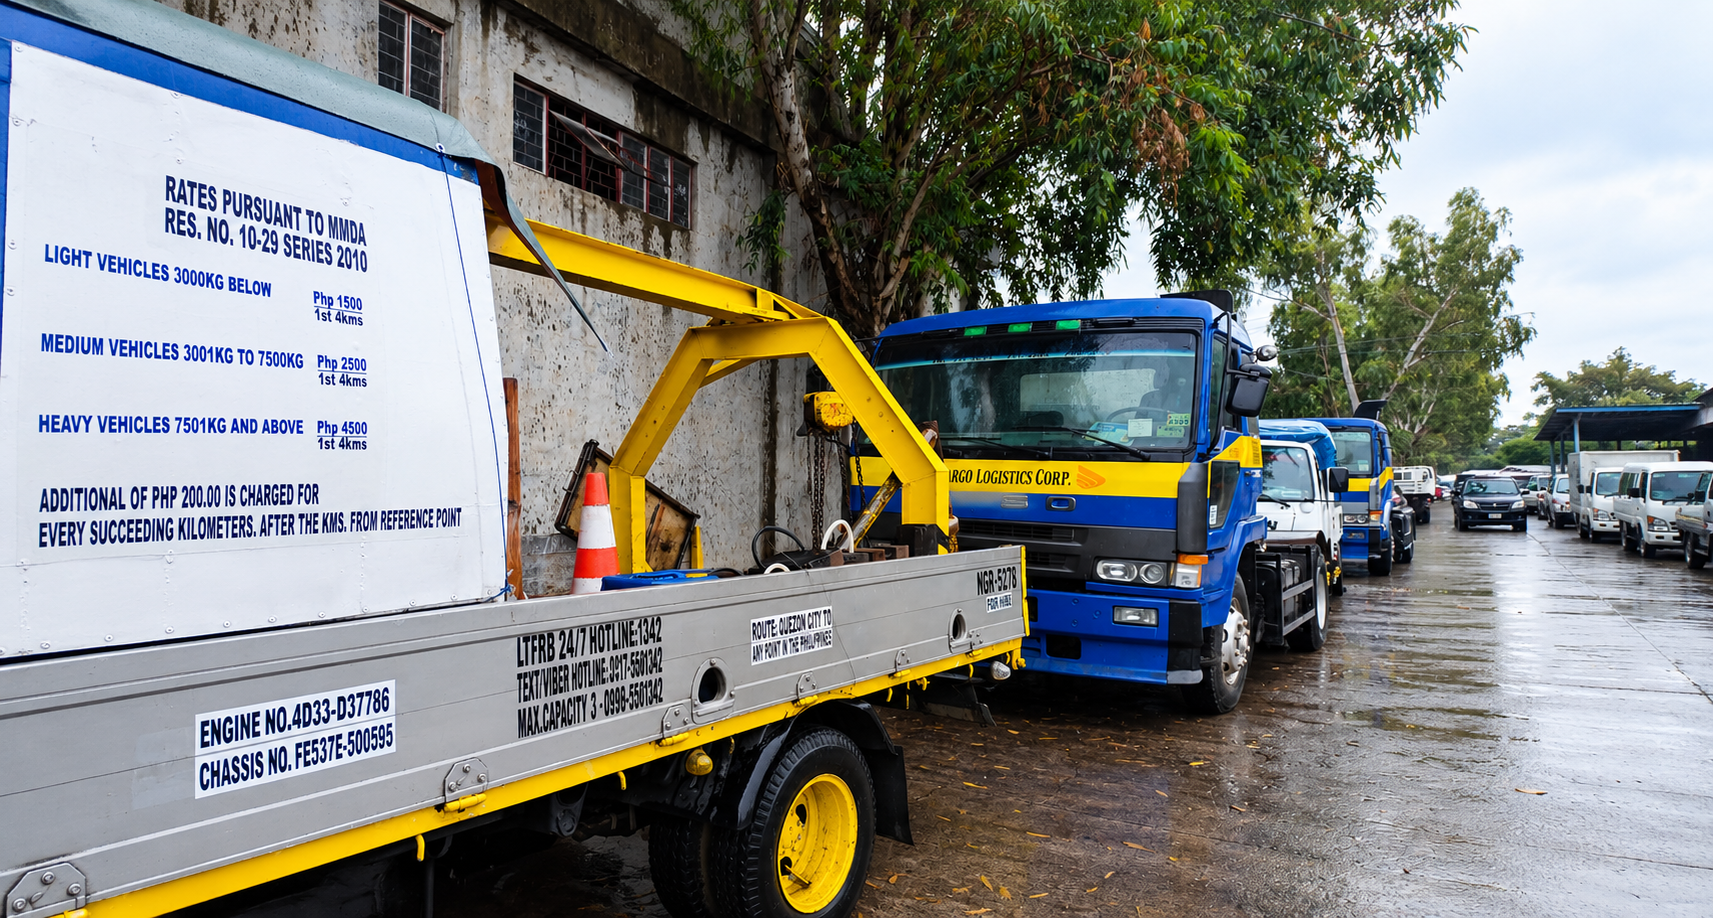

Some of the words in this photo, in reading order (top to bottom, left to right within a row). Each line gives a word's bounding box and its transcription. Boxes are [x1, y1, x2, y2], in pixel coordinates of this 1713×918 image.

[166, 175, 216, 212] RATES
[223, 189, 301, 231] PURSUANT
[306, 209, 324, 236] TO
[328, 214, 366, 246] MMDA
[165, 207, 201, 239] RES.
[207, 216, 234, 246] NO.
[240, 224, 278, 254] 10-29
[284, 233, 332, 266] SERIES
[337, 245, 367, 272] 2010
[45, 244, 92, 269] LIGHT
[97, 253, 169, 281] VEHICLES
[174, 267, 223, 290] 3000KG
[228, 276, 271, 297] BELOW
[313, 291, 333, 308] Php
[337, 295, 362, 310] 1500
[315, 308, 332, 322] 1st
[335, 311, 363, 326] 4kms
[41, 333, 103, 355] MEDIUM
[109, 338, 179, 360] VEHICLES
[184, 344, 233, 364] 3001KG
[237, 349, 254, 365] TO
[258, 351, 304, 369] 7500KG
[317, 355, 337, 371] Php
[341, 357, 366, 371] 2500
[319, 372, 335, 386] 1st
[339, 374, 367, 387] 4kms
[39, 414, 92, 433] HEAVY
[97, 415, 170, 433] VEHICLES
[175, 417, 226, 433] 7501KG
[231, 418, 258, 433] AND
[262, 420, 304, 434] ABOVE
[317, 421, 338, 436] Php
[342, 422, 367, 434] 4500
[318, 438, 335, 450] 1st
[339, 437, 367, 450] 4kms
[976, 469, 1033, 484] LOGISTICS
[1036, 469, 1070, 486] CORP.
[39, 487, 126, 512] ADDITIONAL
[130, 486, 147, 510] OF
[152, 486, 177, 509] PHP
[182, 485, 220, 508] 200.00
[225, 485, 235, 507] IS
[240, 484, 294, 506] CHARGED
[298, 484, 319, 504] FOR
[39, 521, 85, 547] EVERY
[90, 517, 173, 545] SUCCEEDING
[178, 515, 256, 540] KILOMETERS.
[259, 514, 294, 537] AFTER
[299, 513, 318, 534] THE
[322, 512, 346, 533] KMS.
[350, 510, 378, 532] FROM
[380, 508, 434, 531] REFERENCE
[436, 507, 461, 528] POINT
[977, 566, 1017, 595] NGR-5278
[752, 619, 777, 641] ROUTE:
[779, 613, 805, 635] QUEZON
[808, 610, 822, 629] CITY
[823, 609, 831, 626] TO
[517, 632, 555, 667] LTFRB
[559, 628, 586, 660] 24/7
[590, 616, 662, 654] HOTLINE:1342
[753, 644, 763, 662] ANY
[765, 640, 781, 659] POINT
[783, 640, 788, 655] IN
[789, 636, 799, 654] THE
[517, 664, 569, 703] TEXT/VIBER
[200, 711, 260, 748] ENGINE
[266, 687, 389, 735] NO.4D33-D37786
[518, 694, 587, 738] MAX.CAPACITY
[591, 692, 596, 720] 3
[200, 751, 263, 791] CHASSIS
[268, 746, 291, 775] NO.
[295, 723, 393, 769] FE537E-500595
